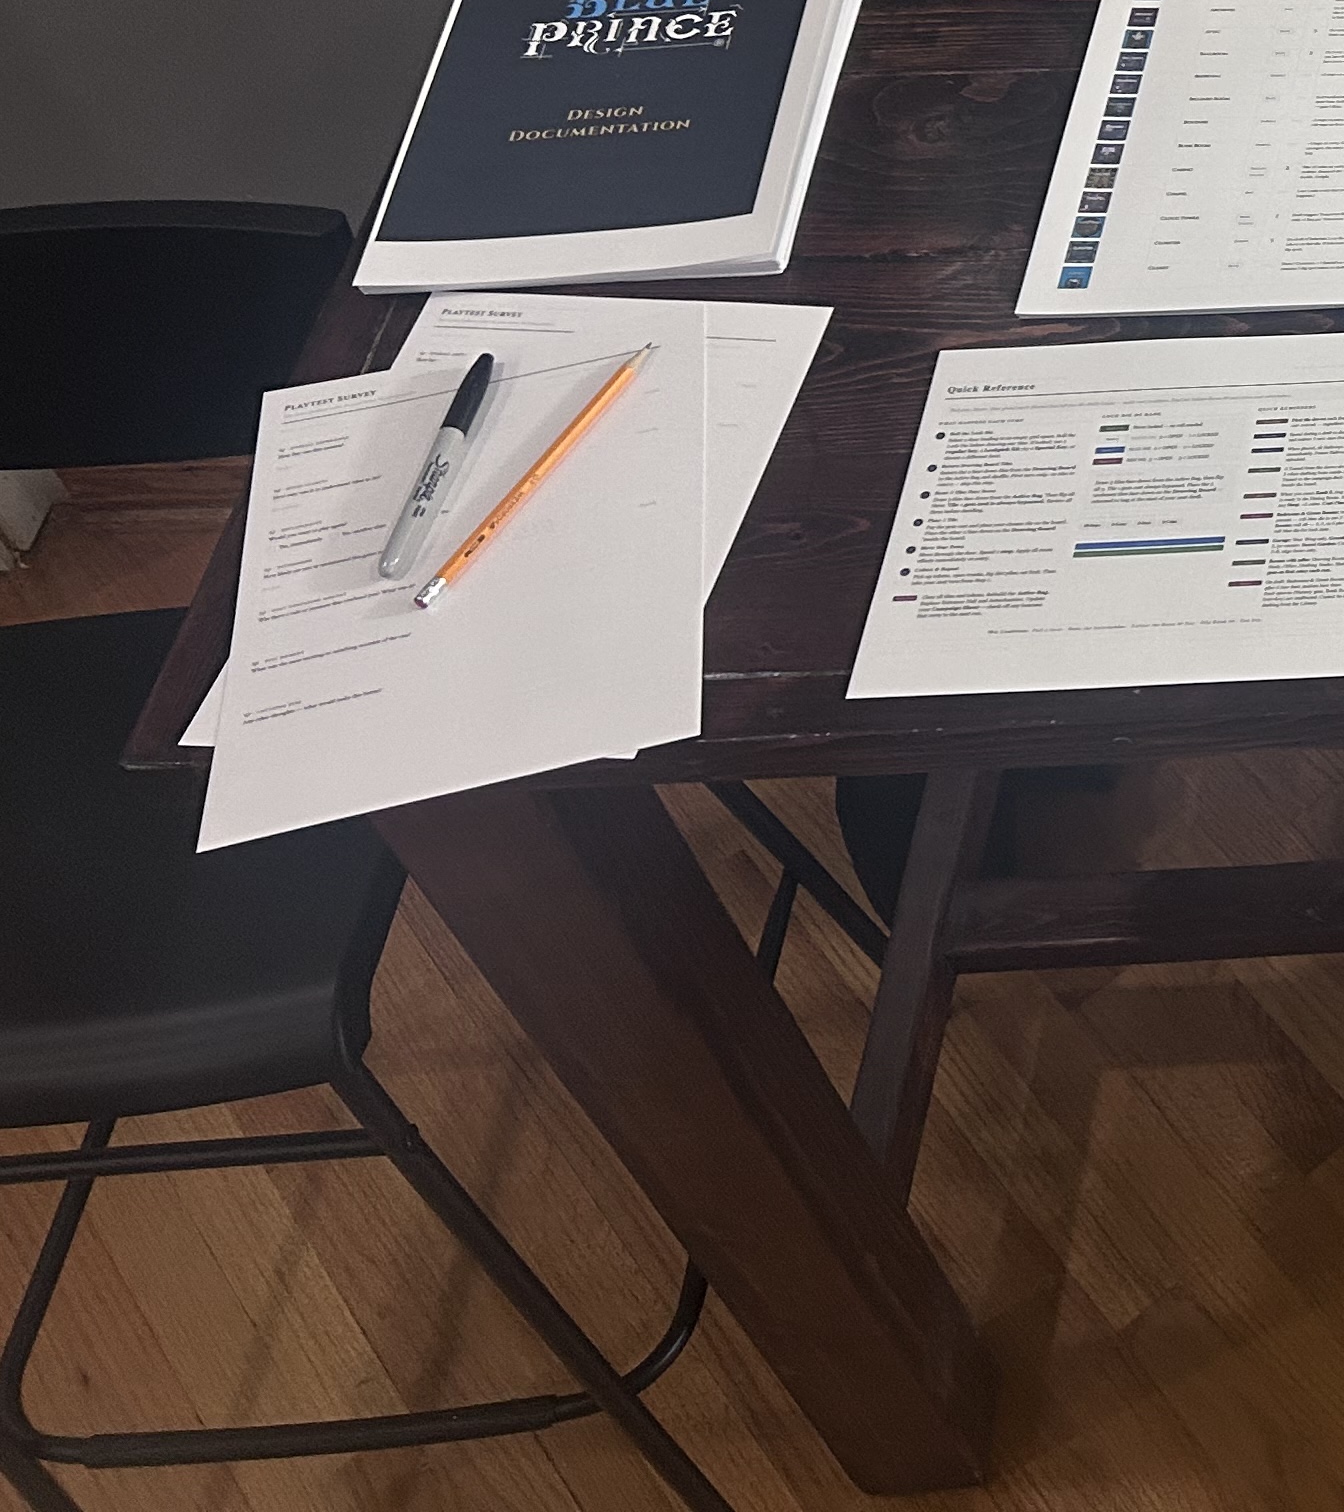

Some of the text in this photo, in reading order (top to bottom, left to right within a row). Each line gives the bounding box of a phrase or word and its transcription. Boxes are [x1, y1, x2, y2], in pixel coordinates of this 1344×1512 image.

[521, 10, 738, 58] PRINCE
[567, 105, 644, 121] DESIGN
[508, 119, 692, 142] DOCUMENTATION
[441, 308, 523, 318] PLAYTEST SURVEY
[947, 384, 1036, 395] Quick Reference
[284, 390, 377, 411] PLAYTEST SURVEY
